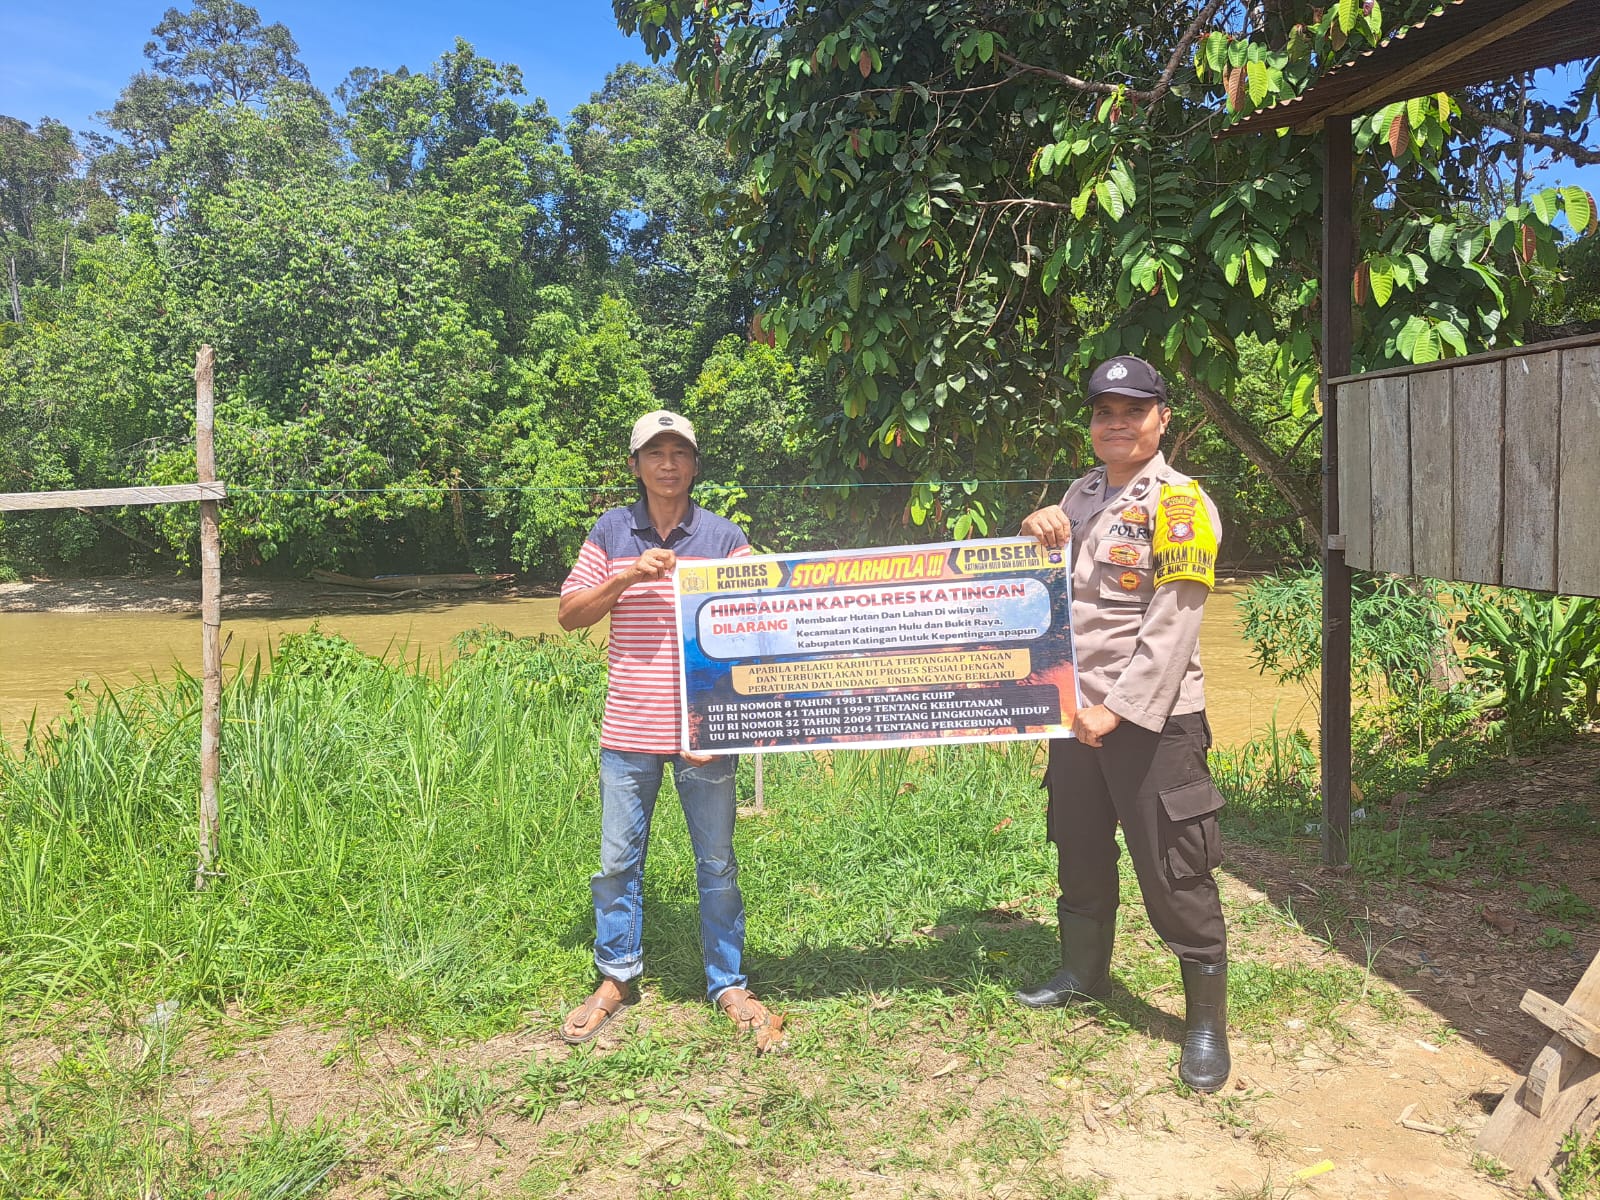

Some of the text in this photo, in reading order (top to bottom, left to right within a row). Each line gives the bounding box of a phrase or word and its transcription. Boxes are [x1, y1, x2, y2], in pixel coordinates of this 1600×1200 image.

[965, 545, 1037, 562] POLSEK
[717, 565, 767, 578] POLRES
[792, 555, 944, 585] STOP KARHUTLA !!!
[717, 578, 768, 589] KATINGAN
[711, 584, 1025, 617] HIMBAUAN KAPOLRES KATINGAN
[795, 615, 848, 625] Membakar
[850, 612, 880, 621] Hutan
[903, 609, 933, 618] Lahan
[948, 605, 988, 617] wilayah
[713, 619, 788, 634] DILARANG
[797, 628, 850, 637] Kecamatan
[853, 624, 897, 636] Katingan
[899, 622, 922, 631] Hulu
[924, 621, 943, 629] dan
[945, 619, 972, 628] Bukit
[798, 628, 1037, 649] Kabupaten Katingan Untuk Kepentingan apapun
[748, 653, 1012, 675] APABILA PELAKU KARHUTLA TERTANGKAP TANGAN
[756, 675, 777, 683] DAN
[880, 667, 919, 676] PROSES
[922, 664, 958, 673] SESUAI
[961, 663, 1004, 672] DENGAN
[748, 683, 809, 693] PERATURAN
[812, 681, 832, 689] DAN
[836, 679, 879, 687] UNDANG
[888, 676, 931, 684] UNDANG
[934, 673, 962, 682] YANG
[965, 671, 1015, 681] BERLAKU
[708, 714, 725, 722] UU
[727, 713, 738, 721] RI
[740, 710, 782, 720] NOMOR
[801, 708, 840, 716] TAHUN
[843, 705, 873, 714] 1999
[875, 702, 927, 712] TENTANG
[930, 699, 1003, 709] KEHUTANAN
[740, 701, 782, 711] NOMOR
[785, 700, 791, 708] 8
[794, 698, 832, 708] TAHUN
[836, 696, 862, 705] 1981
[866, 693, 919, 704] TENTANG
[922, 691, 955, 700] KUHP
[709, 723, 726, 731] UU
[741, 720, 783, 730] NOMOR
[786, 719, 800, 727] 32
[802, 717, 841, 726] TAHUN
[843, 715, 874, 724] 2009
[876, 712, 928, 722] TENTANG
[931, 708, 1009, 719] LINGKUNGAN
[1011, 706, 1049, 715] HIDUP
[709, 733, 726, 741] UU
[728, 732, 739, 740] RI
[741, 730, 784, 739] NOMOR
[803, 726, 842, 736] TAHUN
[845, 724, 873, 733] 2014
[876, 721, 929, 732] TENTANG
[932, 718, 1012, 729] PERKEBUNAN
